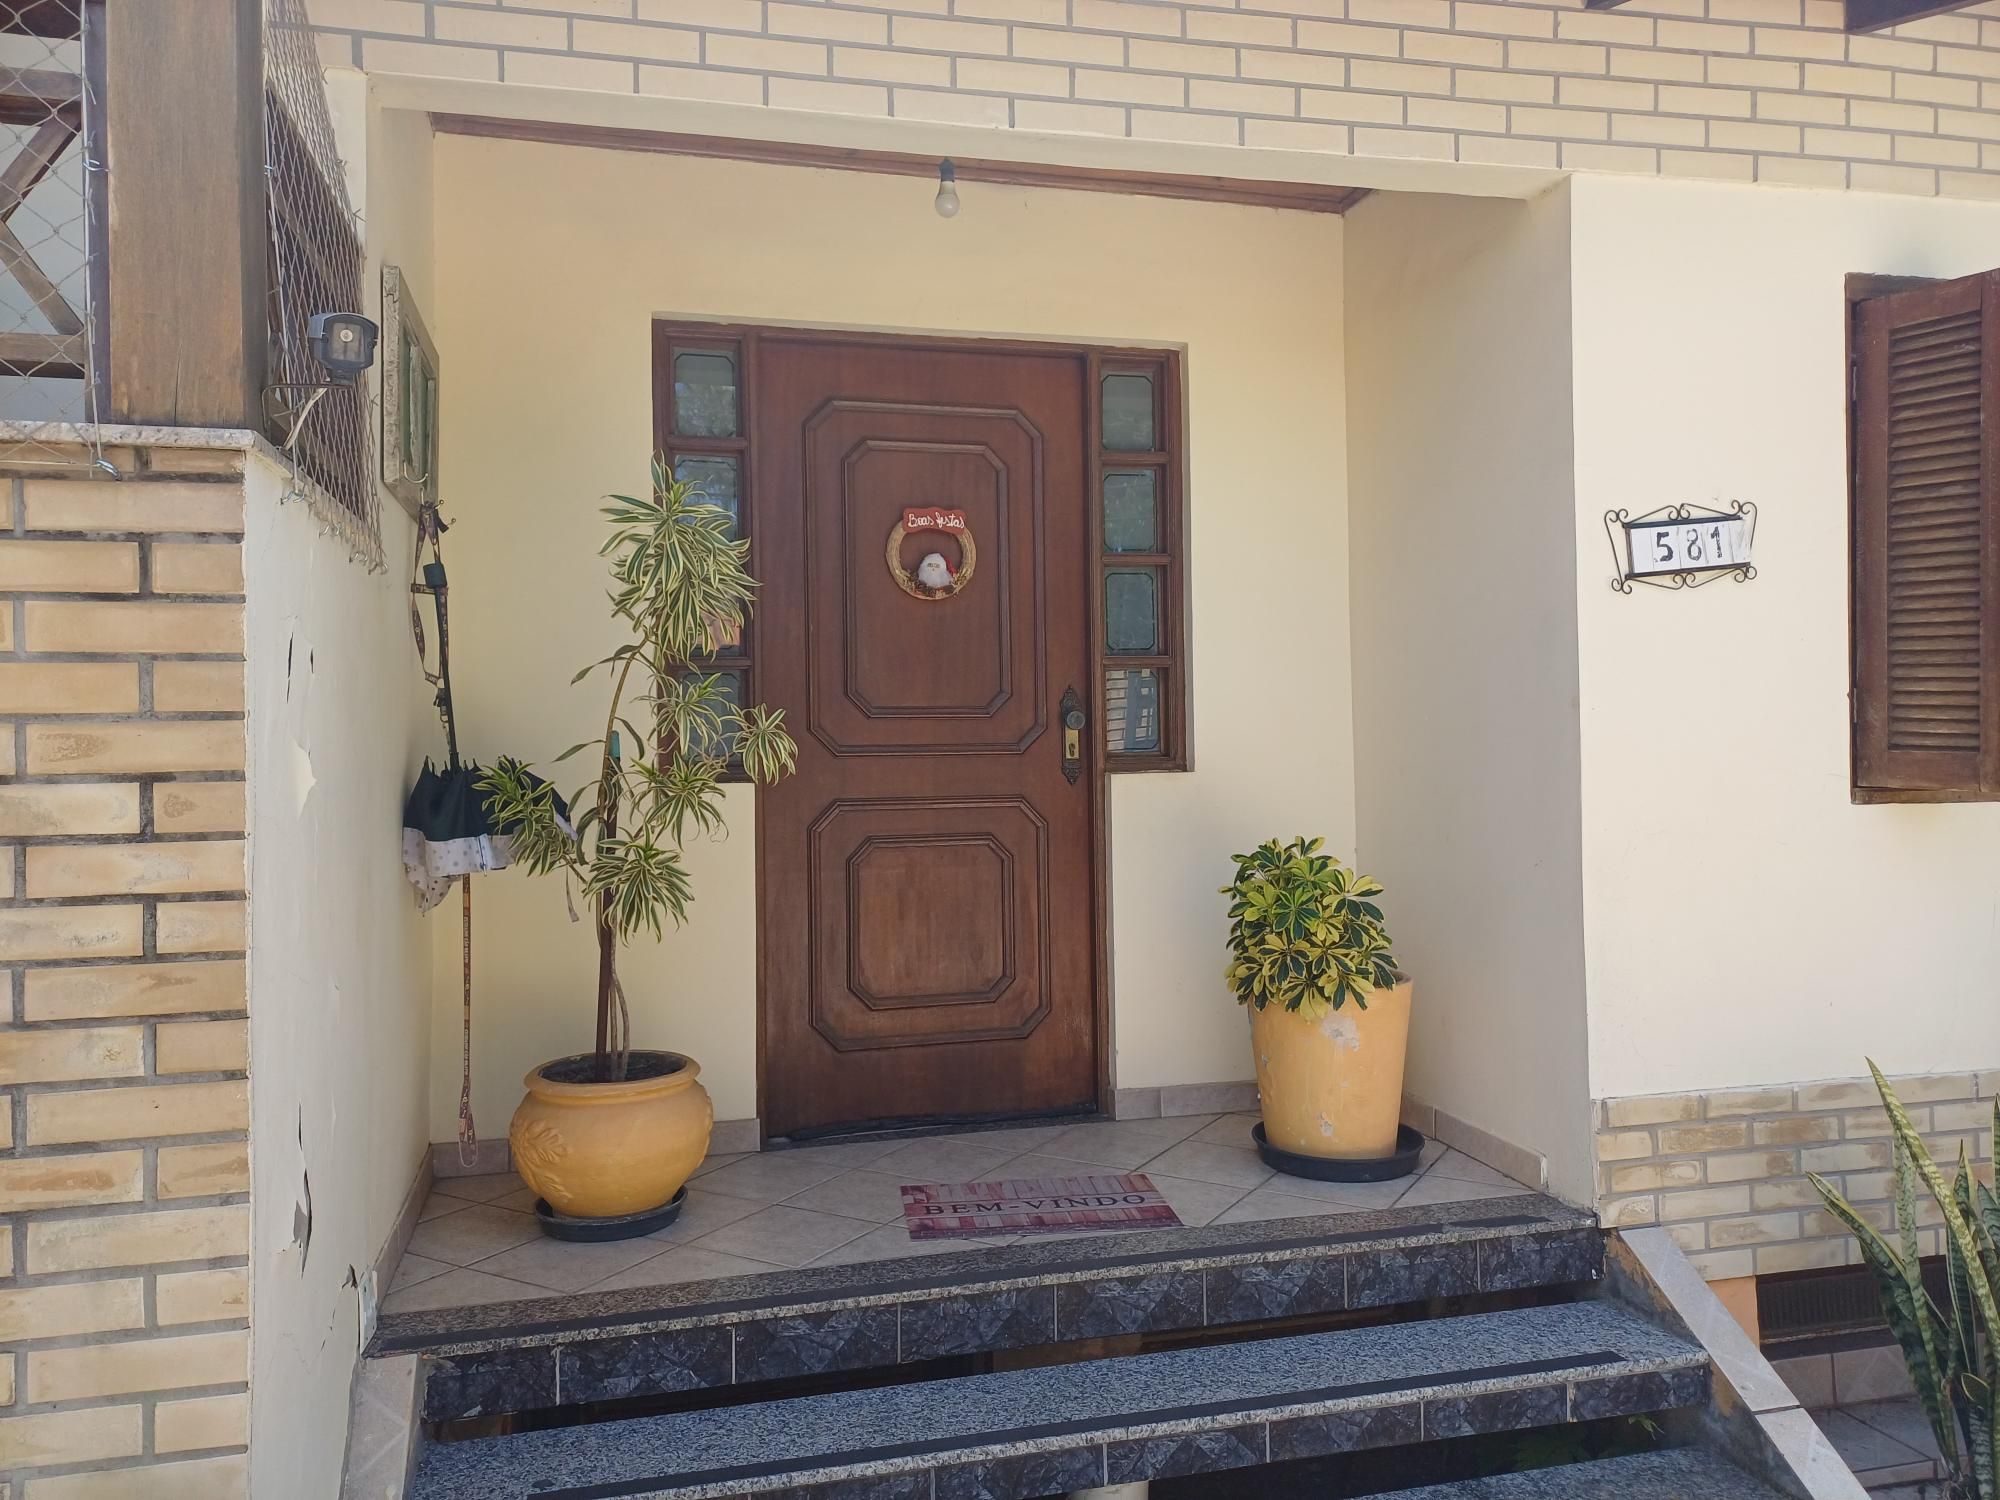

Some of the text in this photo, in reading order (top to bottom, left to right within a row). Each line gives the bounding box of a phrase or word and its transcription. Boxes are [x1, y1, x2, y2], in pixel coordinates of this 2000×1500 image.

[908, 511, 965, 529] Boas festas
[1655, 526, 1723, 562] 581
[924, 1194, 1146, 1215] BEM-VINDO
